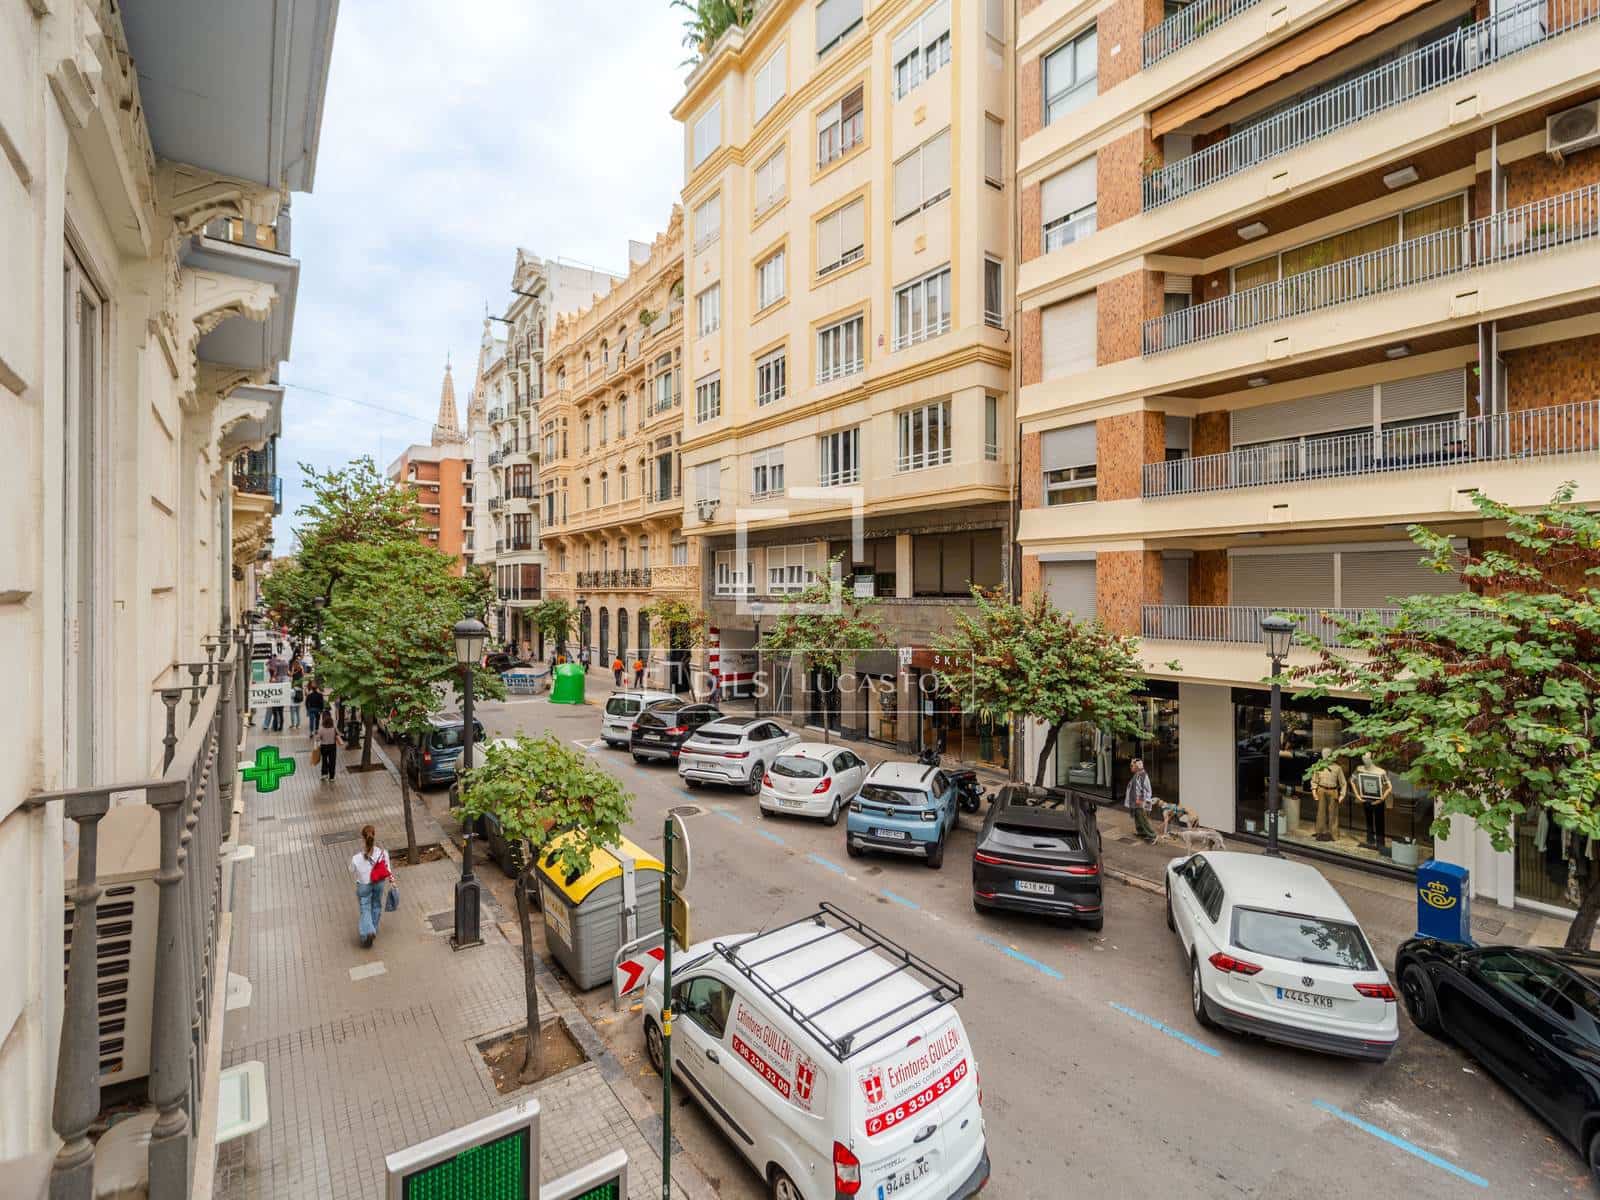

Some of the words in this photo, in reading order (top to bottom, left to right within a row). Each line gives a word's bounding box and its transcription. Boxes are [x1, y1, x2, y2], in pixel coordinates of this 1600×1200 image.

[1284, 989, 1310, 1004] 4445
[750, 1053, 765, 1073] 330
[778, 1079, 789, 1092] 09
[887, 1054, 929, 1089] Extintores
[885, 1107, 905, 1126] 96
[908, 1089, 934, 1113] 330
[936, 1076, 952, 1094] 33
[953, 1062, 966, 1079] 09
